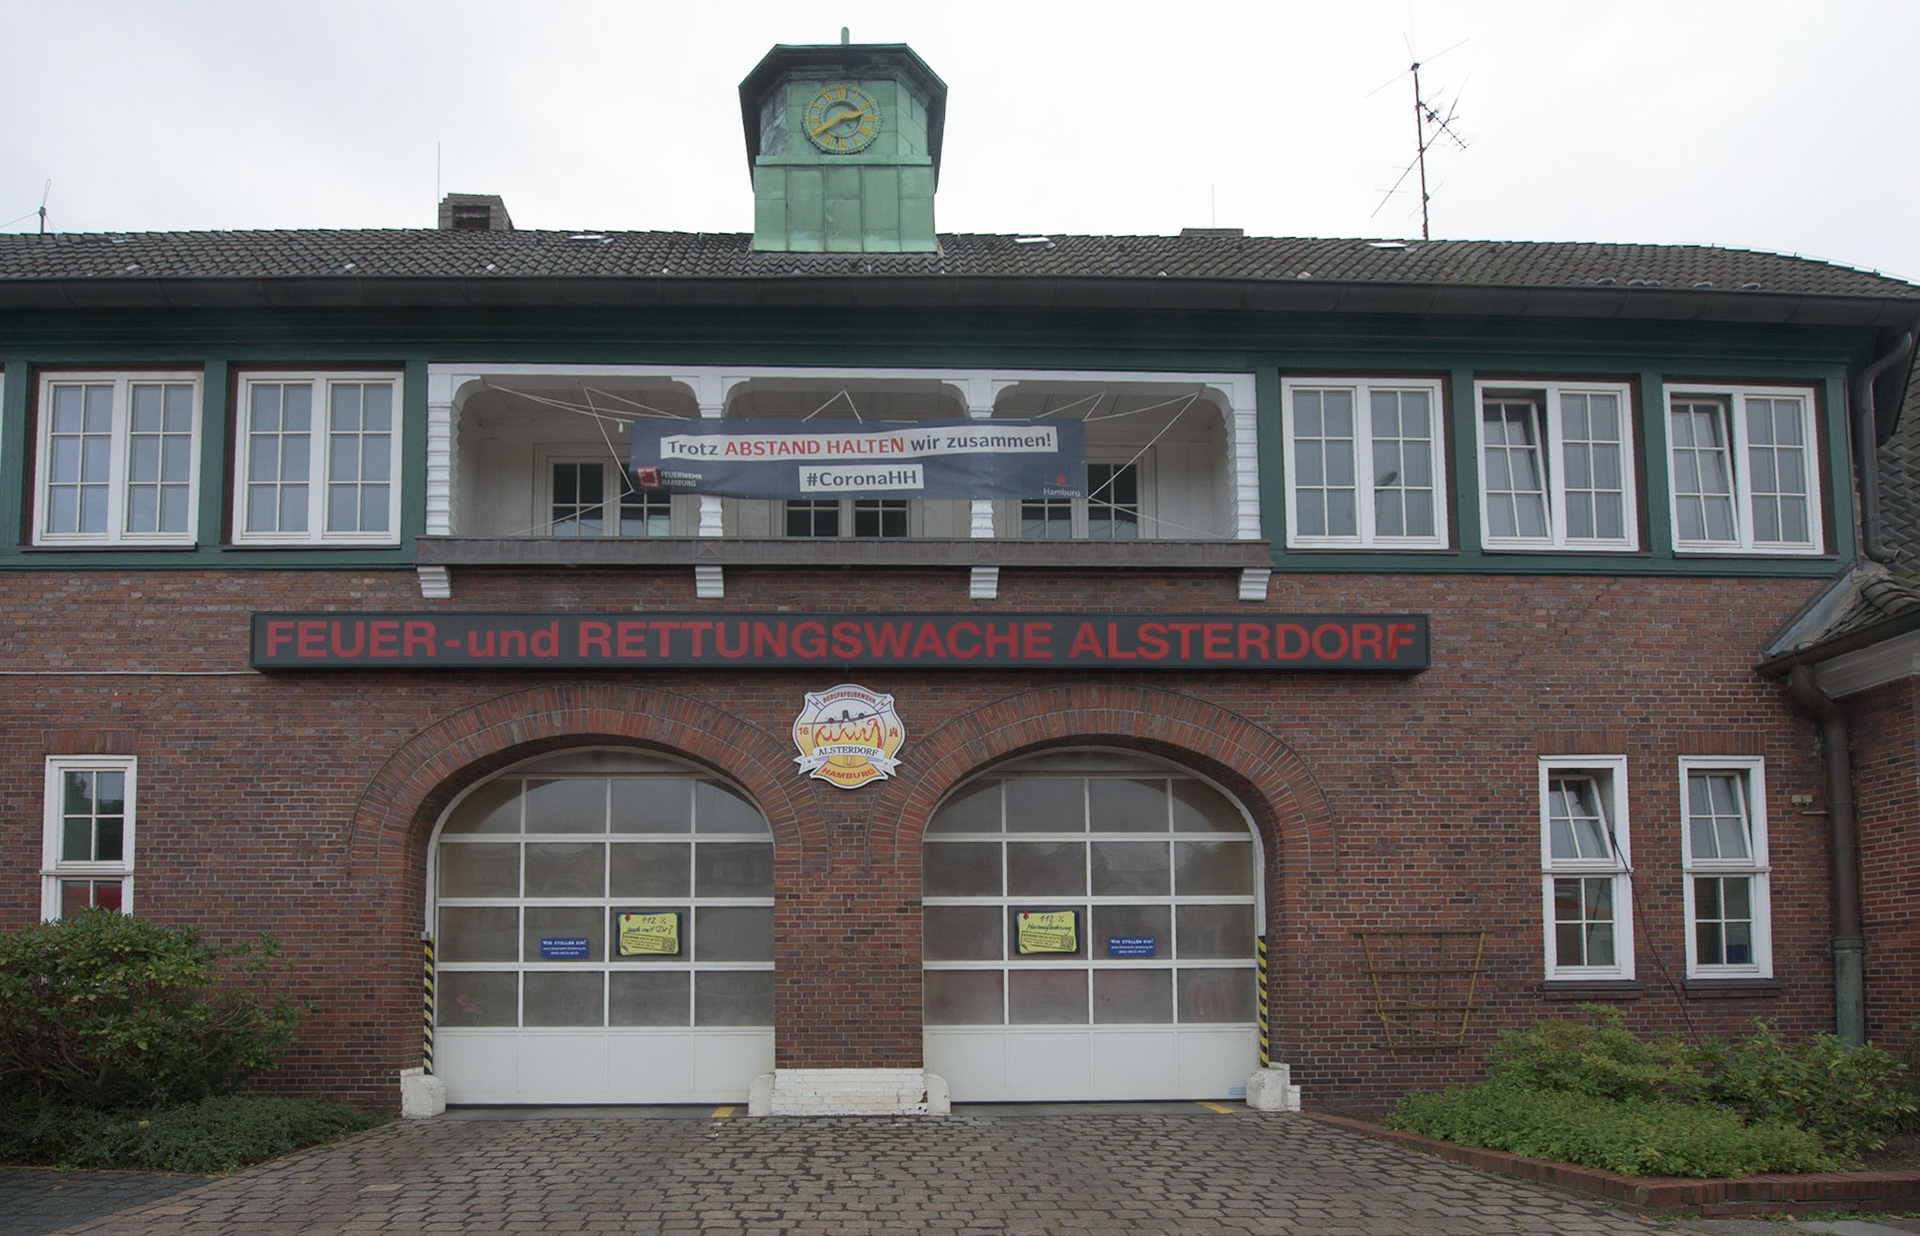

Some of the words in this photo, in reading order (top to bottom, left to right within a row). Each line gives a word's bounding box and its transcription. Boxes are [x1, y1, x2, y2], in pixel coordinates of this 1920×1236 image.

[667, 440, 719, 457] Trotz
[724, 440, 821, 456] ABSTAND
[827, 437, 905, 455] HALTEN
[911, 434, 940, 452] wir
[946, 432, 1052, 449] zusammen!
[660, 470, 703, 480] FEUERWEHR
[806, 470, 917, 487] #CoronaHH
[661, 479, 697, 488] HAMBURG
[1043, 487, 1081, 498] Hamburg
[577, 620, 1054, 660] RETTUNGSWACHE
[1068, 621, 1416, 661] ALSTERDORF
[798, 727, 809, 735] 16
[818, 746, 879, 756] ALSTERDORF
[821, 768, 876, 779] HAMBURG
[641, 916, 656, 924] 112
[1039, 914, 1054, 922] 112
